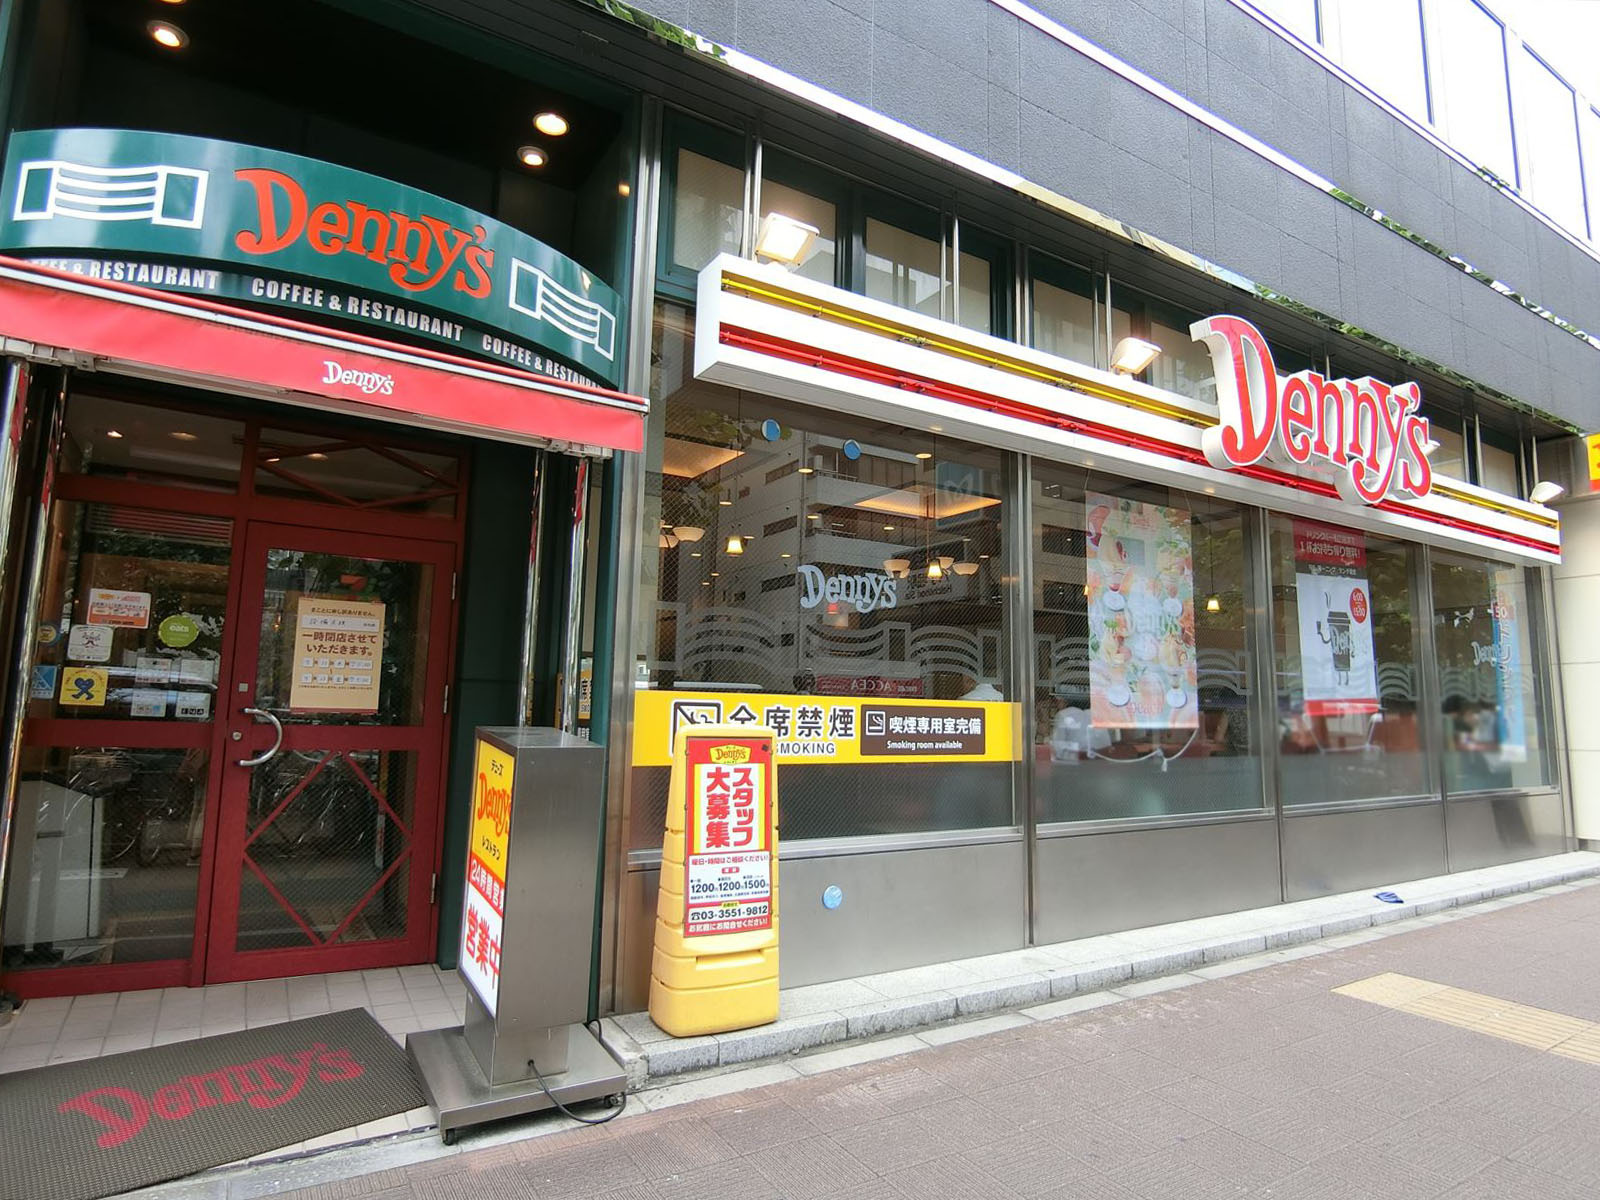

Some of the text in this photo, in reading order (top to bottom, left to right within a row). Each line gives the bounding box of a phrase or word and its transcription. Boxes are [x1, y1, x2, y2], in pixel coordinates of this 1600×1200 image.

[234, 168, 495, 299] Denny's
[90, 261, 219, 290] RESTAURANT
[252, 278, 464, 342] COFFEE & RESTAURANT
[482, 334, 532, 367] COFFEE
[535, 356, 543, 371] &
[323, 361, 395, 395] Denny's
[1193, 314, 1432, 504] Denny's
[302, 631, 379, 644] 一時閉店させて
[306, 643, 373, 657] いただきます。
[889, 716, 982, 735] 喫煙専用室完備
[715, 747, 746, 761] Denny's
[776, 743, 835, 754] MOKING
[887, 740, 963, 751] Smoking room available
[706, 766, 730, 848] 大募集
[732, 767, 754, 847] スタッフ
[466, 903, 502, 990] 営業中
[57, 1041, 367, 1150] Denny's
